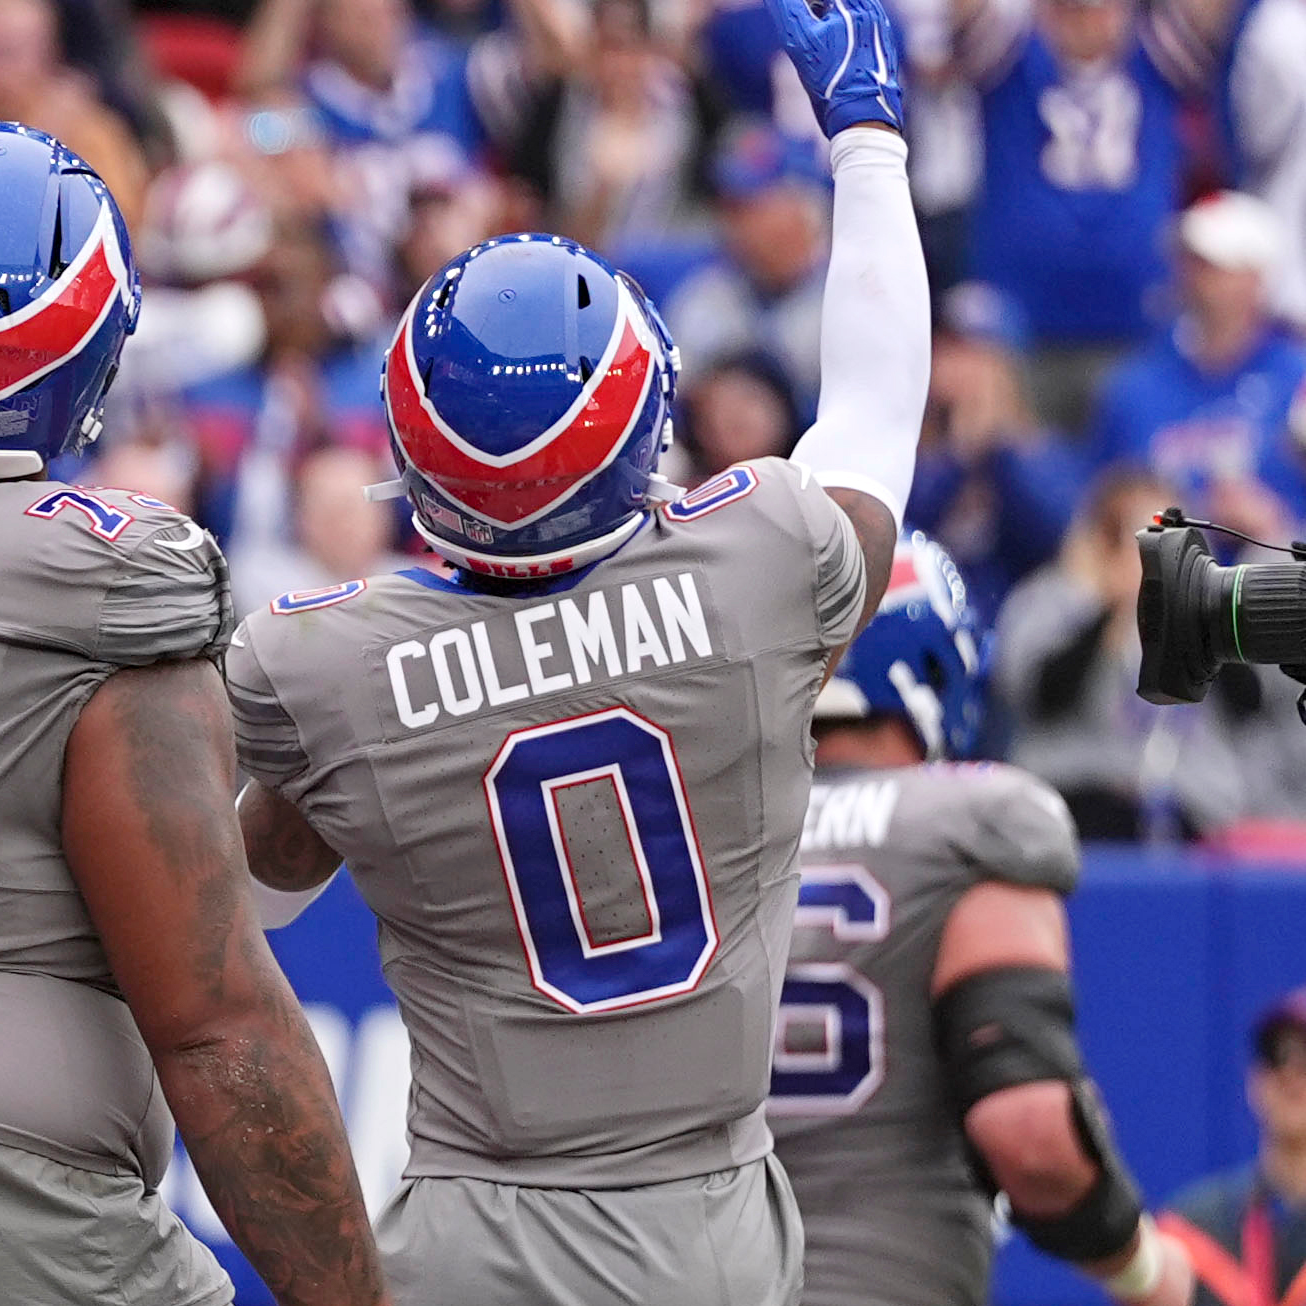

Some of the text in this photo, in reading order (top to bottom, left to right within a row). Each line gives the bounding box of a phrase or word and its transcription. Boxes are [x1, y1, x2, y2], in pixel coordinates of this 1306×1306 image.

[466, 556, 574, 578] BILLS
[386, 573, 714, 729] COLEMAN
[483, 705, 720, 1014] 0
